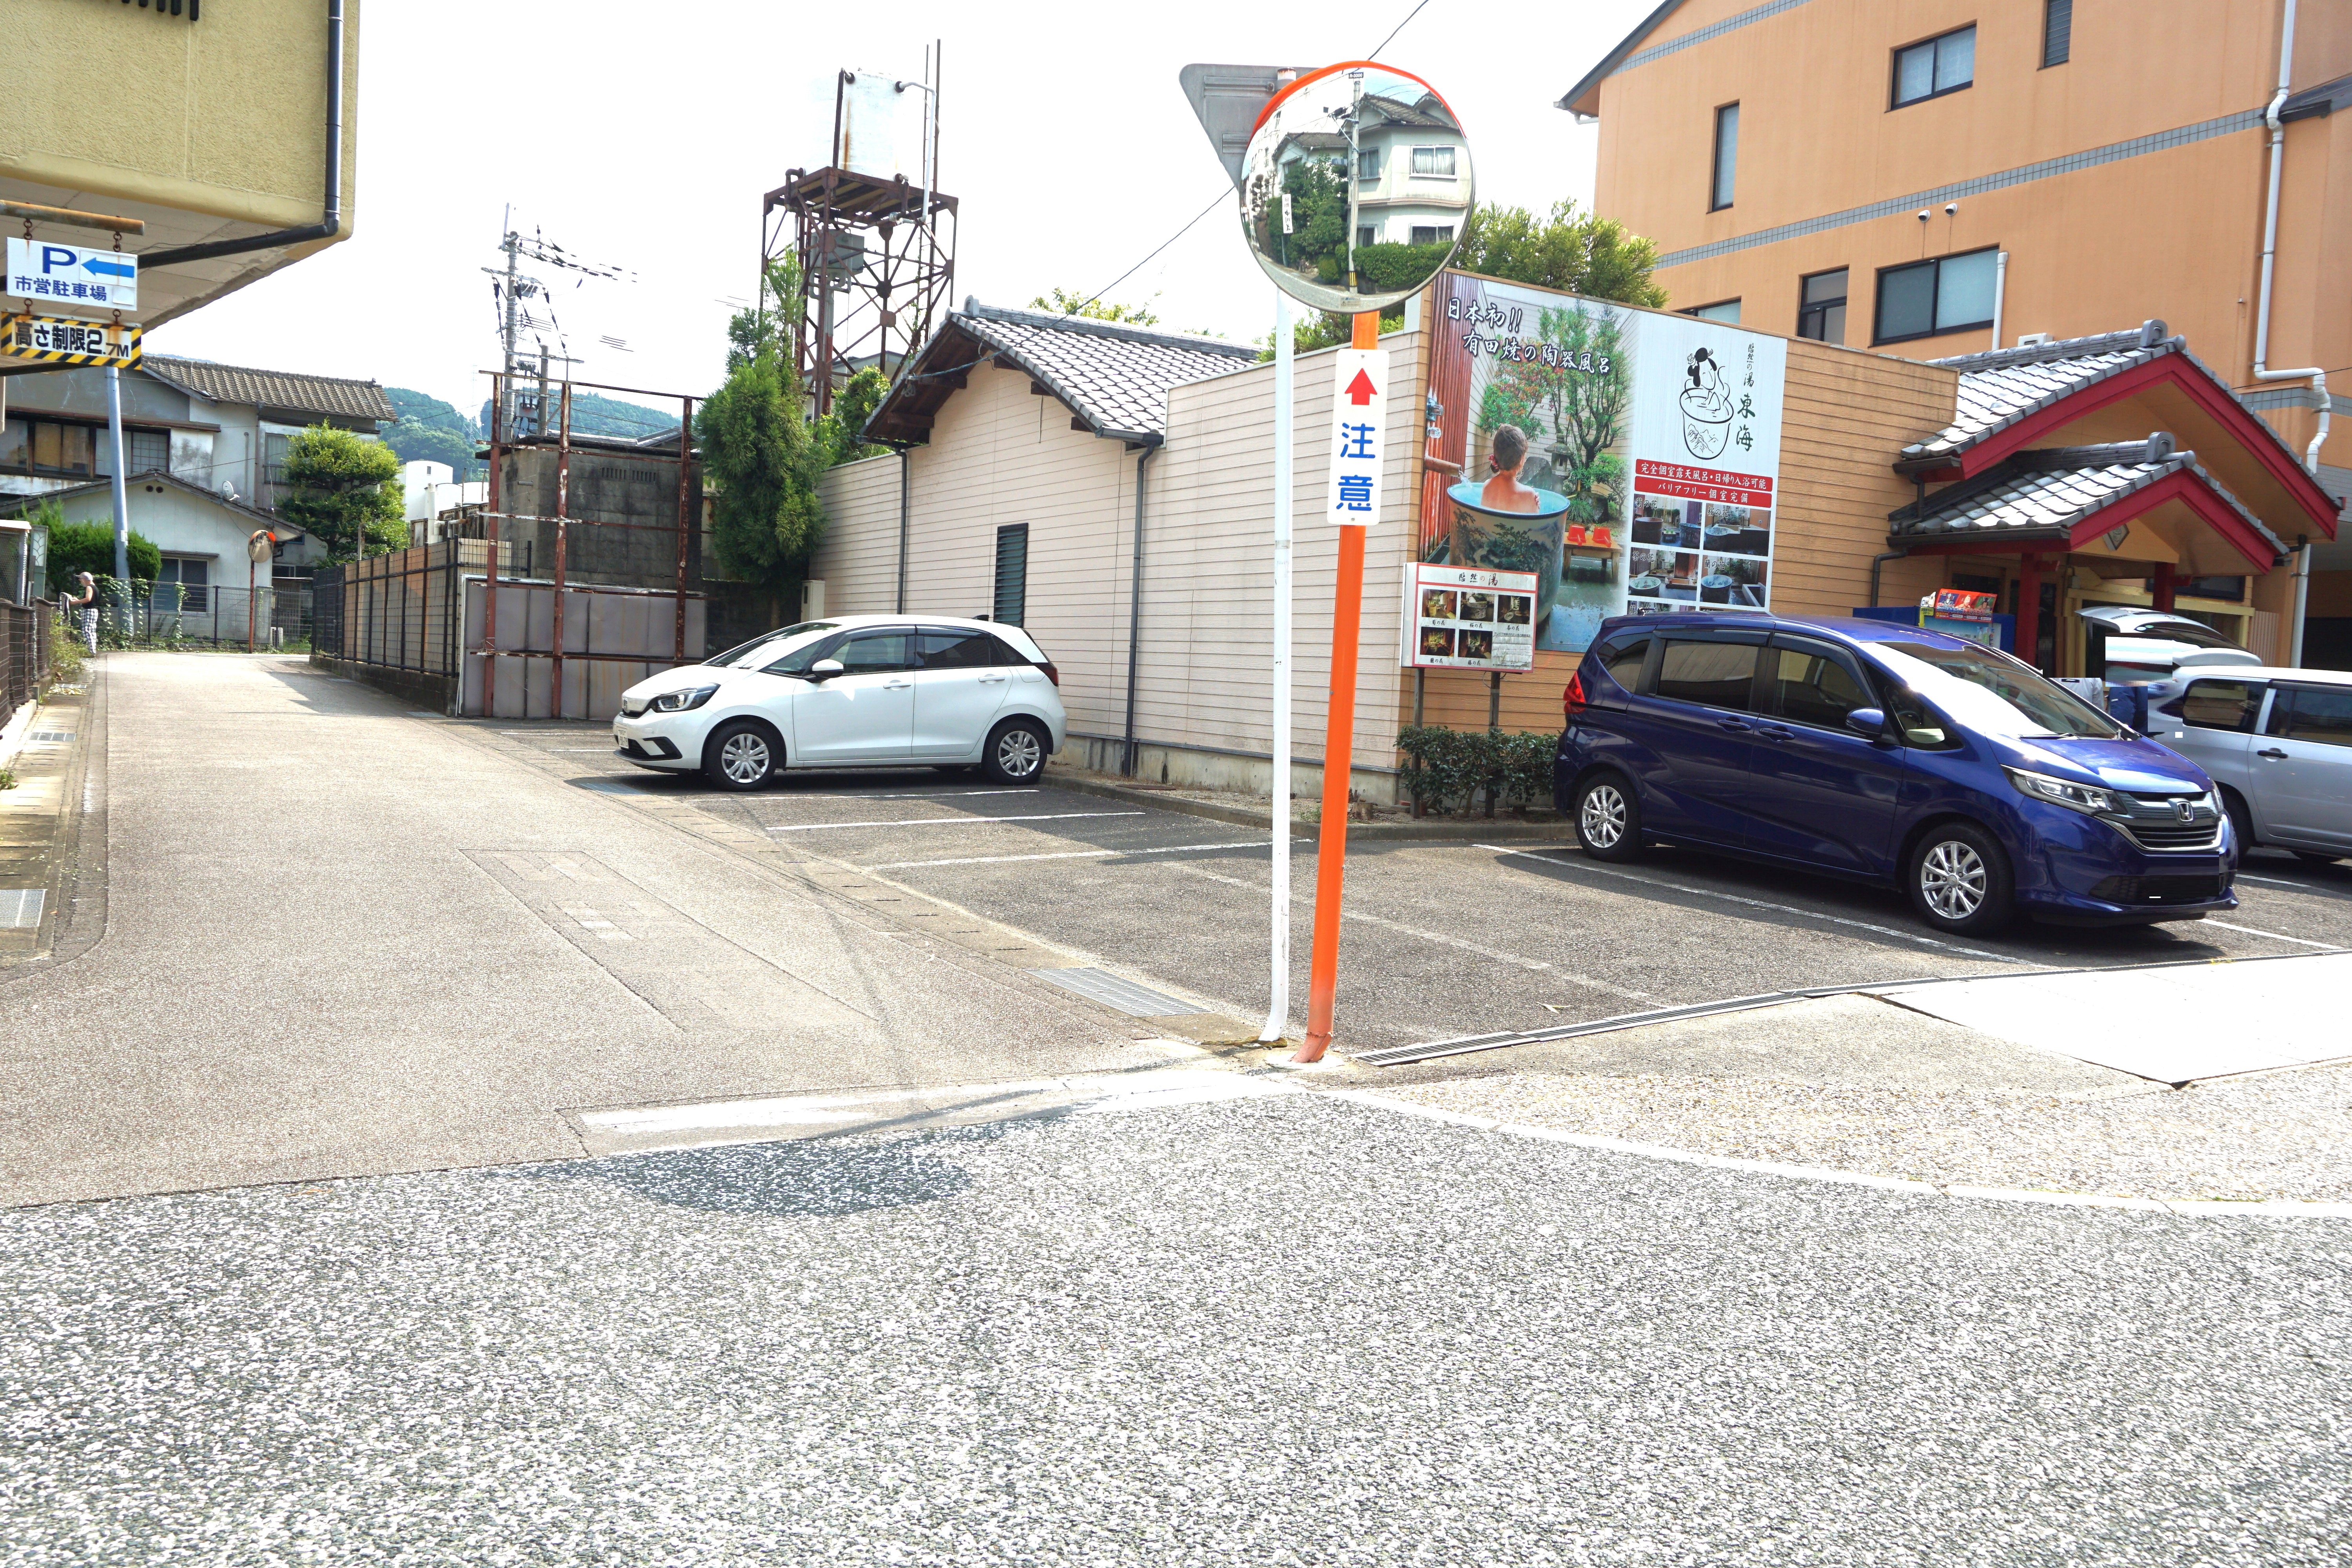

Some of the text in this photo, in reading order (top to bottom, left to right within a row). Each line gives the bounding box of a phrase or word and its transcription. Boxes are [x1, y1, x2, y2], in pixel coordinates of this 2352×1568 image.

[42, 246, 77, 274] P
[15, 275, 107, 301] 市営駐車場
[15, 321, 129, 358] 高さ制限2.7M
[1463, 329, 1611, 375] 有田焼の陶器風呂
[1744, 343, 1755, 388] 悠然の湯
[1736, 392, 1755, 452] 東海
[1336, 422, 1376, 512] 注意
[1636, 497, 1657, 509] 菊の花
[1658, 482, 1748, 504] バリアフリー個室完備
[1707, 506, 1729, 518] 桜の花
[1704, 558, 1725, 570] 蘭の花
[1459, 572, 1498, 586] 悠然の湯
